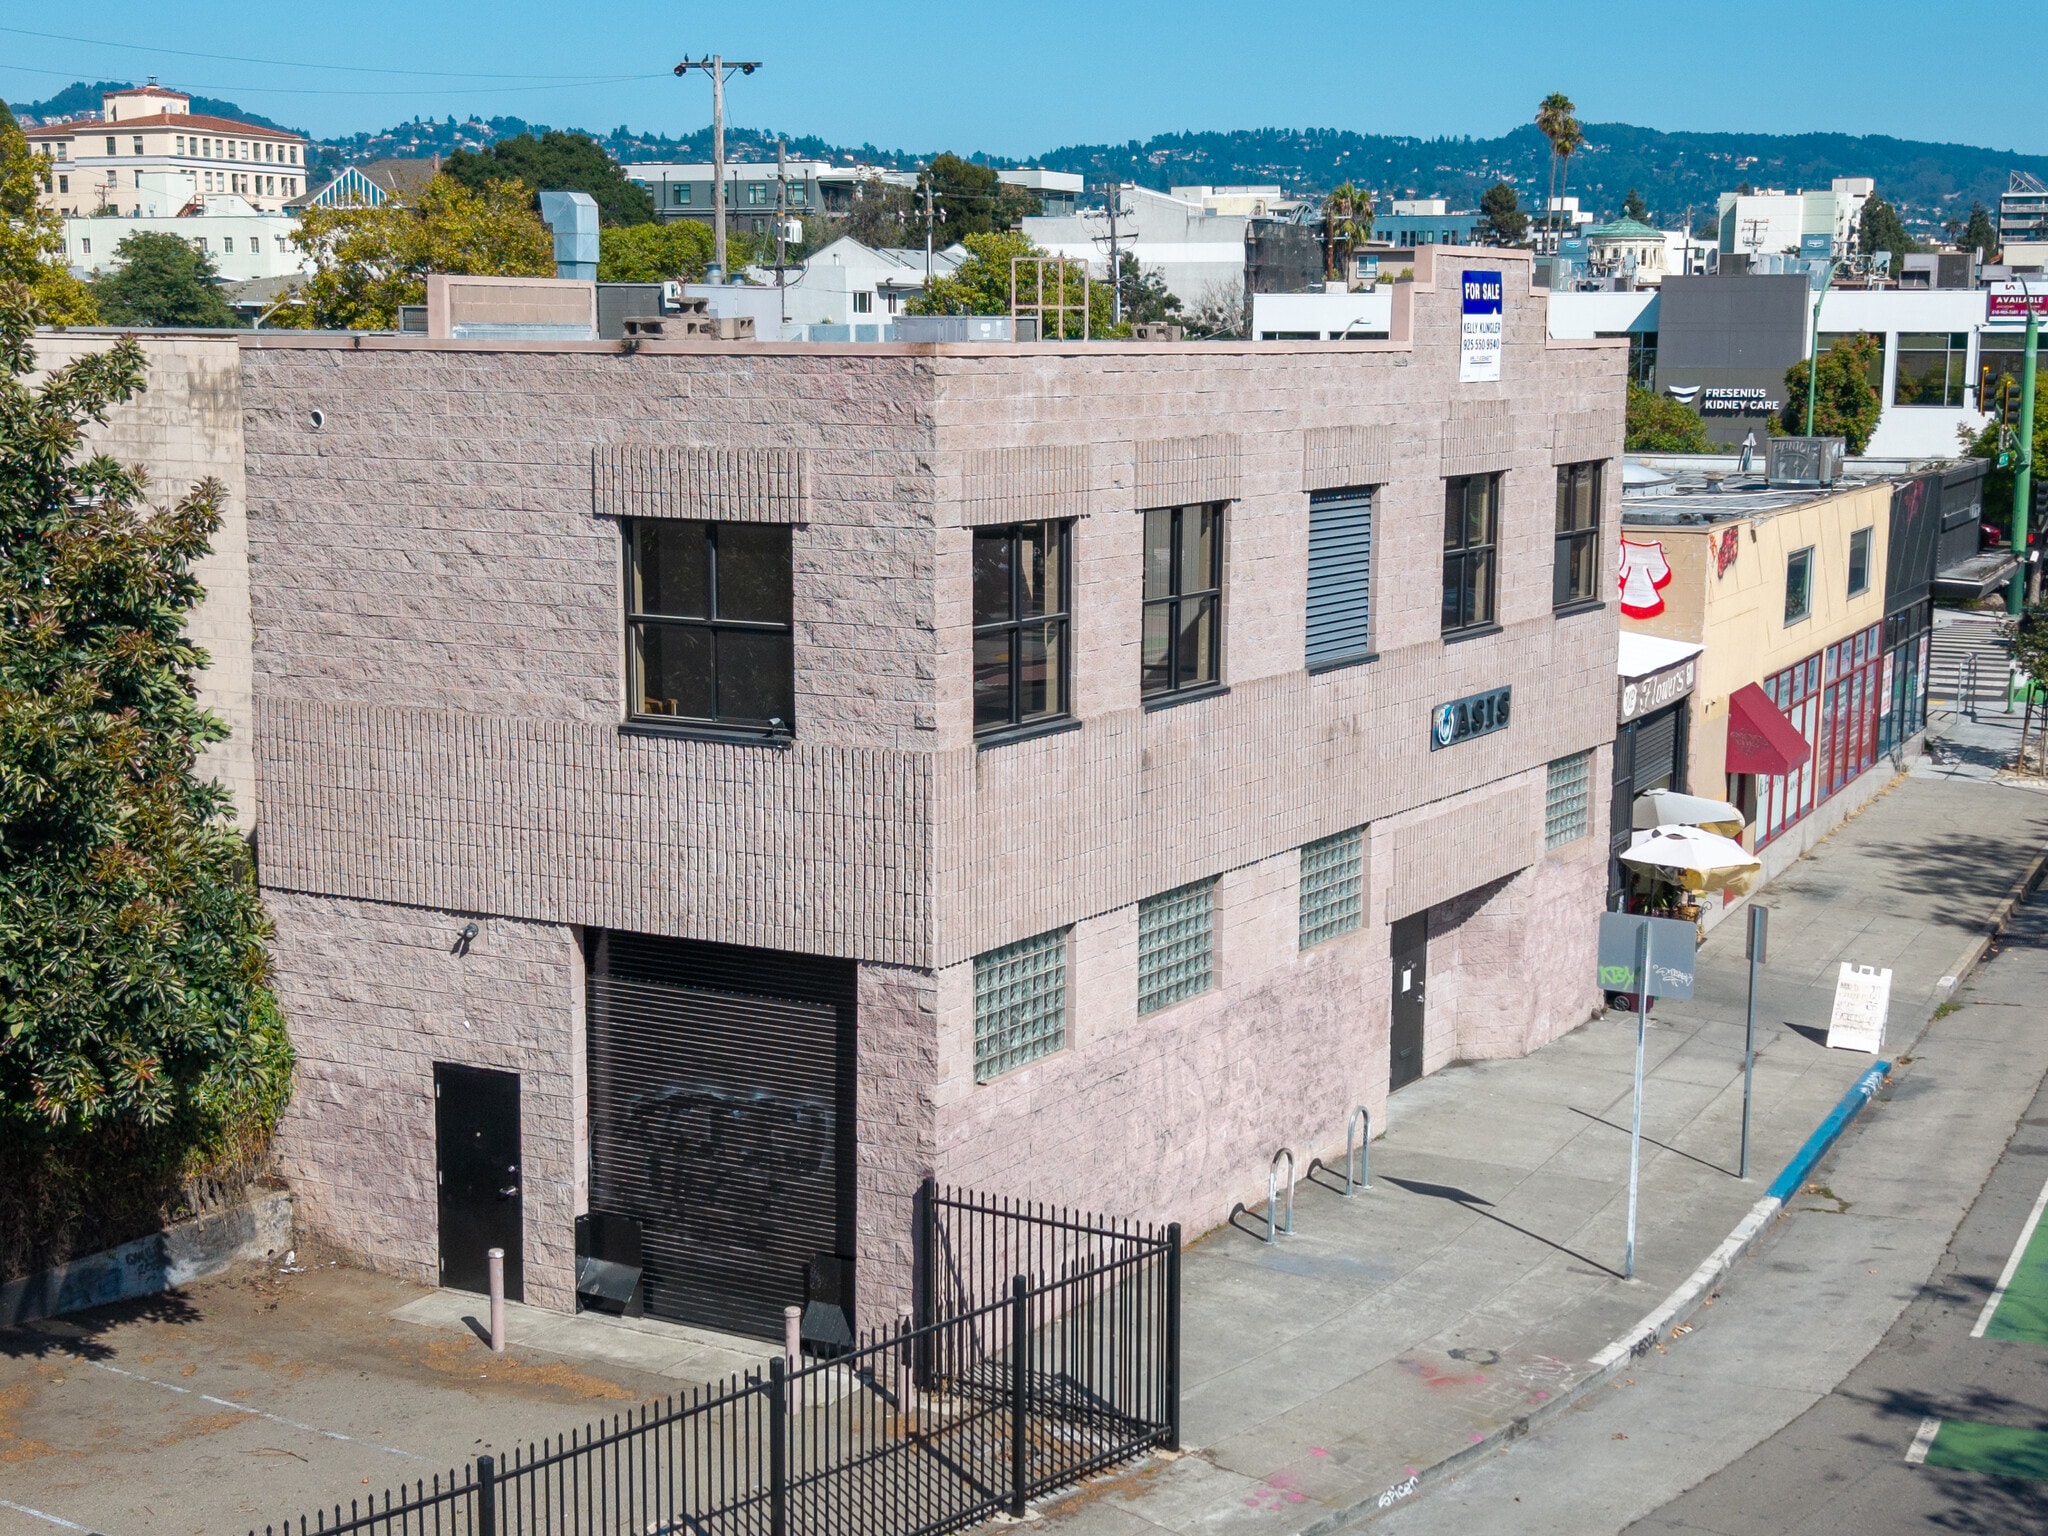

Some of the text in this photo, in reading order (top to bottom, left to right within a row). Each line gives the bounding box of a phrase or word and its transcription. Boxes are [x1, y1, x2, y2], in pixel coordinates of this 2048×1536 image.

[1465, 283, 1500, 299] FOR SALE
[1463, 322, 1500, 333] KELLY KLINGLER
[1705, 388, 1767, 398] FRESENIUS
[1705, 400, 1780, 410] KIDNEY CARE
[1438, 691, 1510, 745] OASIS
